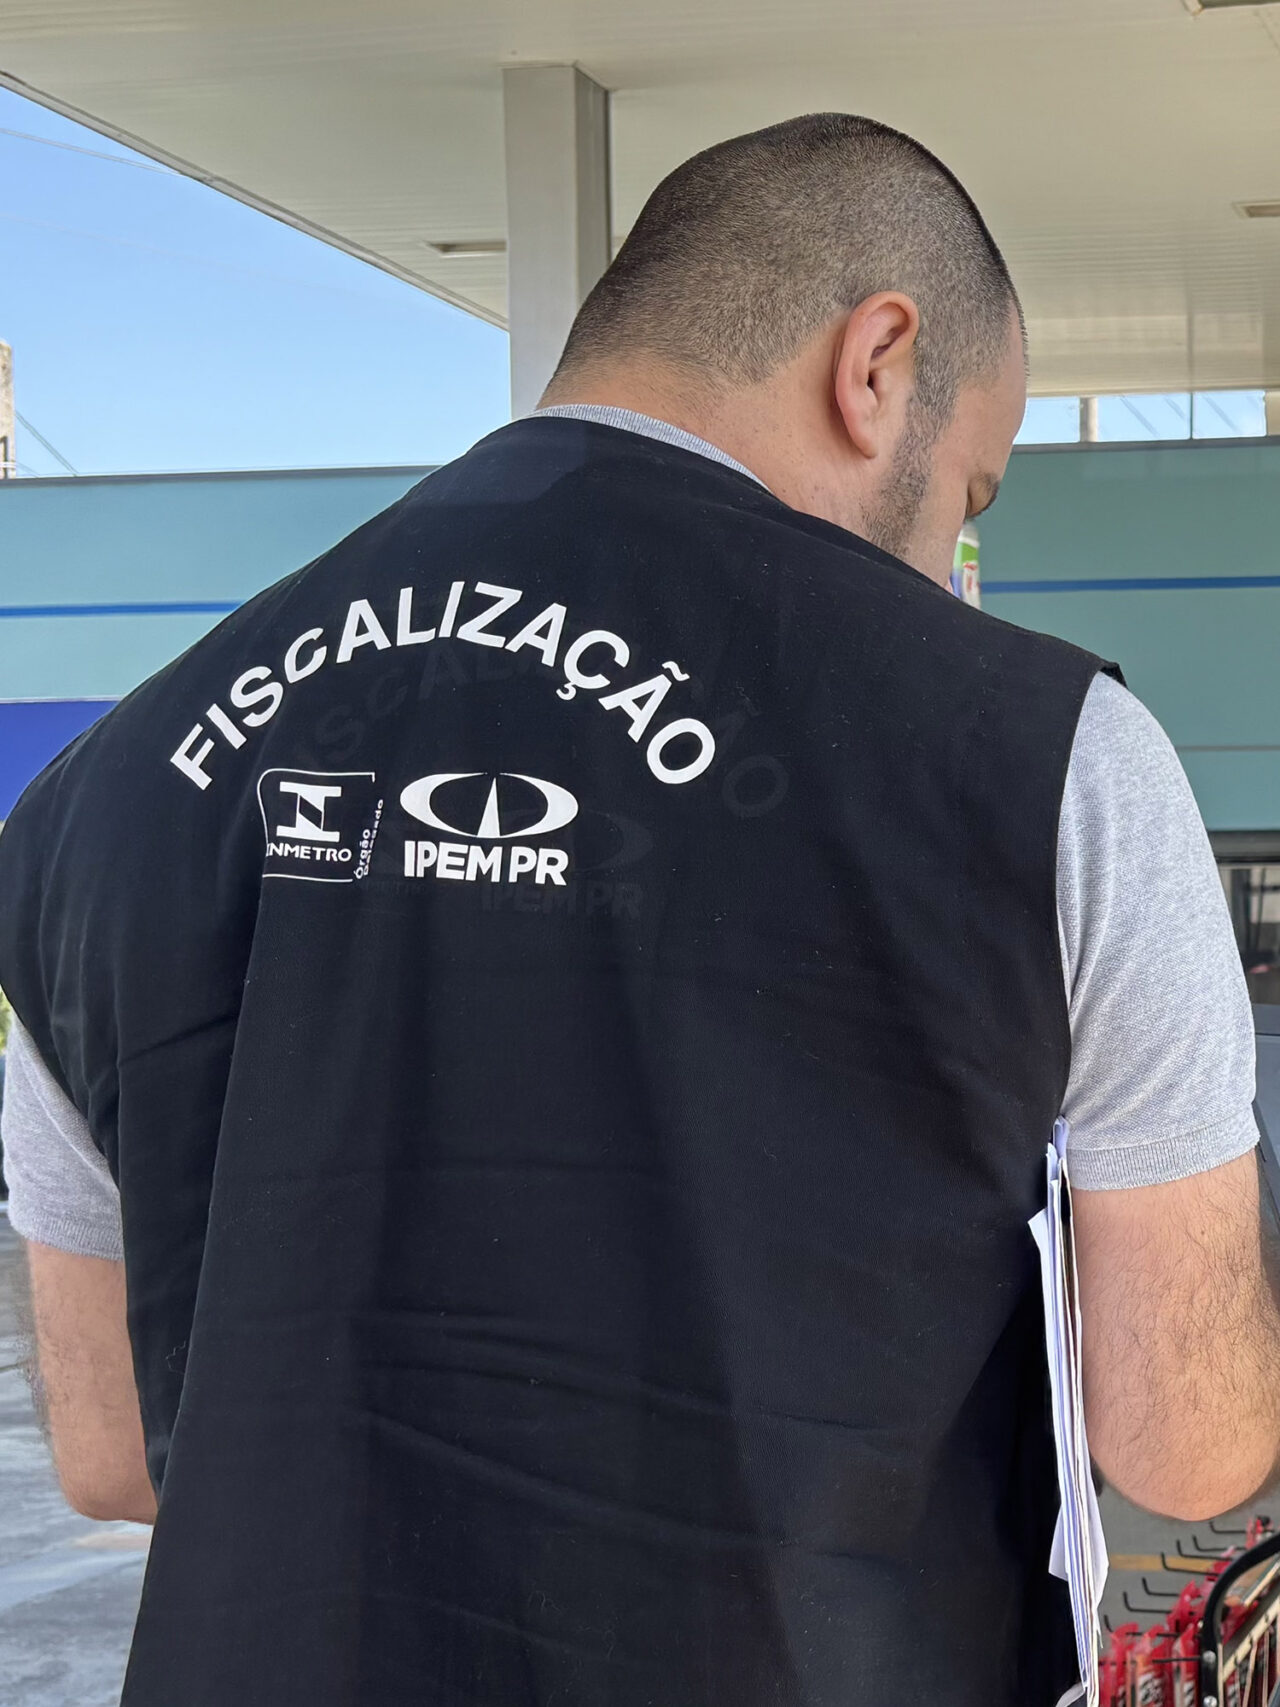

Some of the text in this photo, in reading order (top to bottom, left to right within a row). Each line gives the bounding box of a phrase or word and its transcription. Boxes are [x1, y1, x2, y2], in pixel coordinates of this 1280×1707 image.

[170, 581, 716, 791] FISCALIZAÇÃO
[404, 840, 569, 886] IPEM PR
